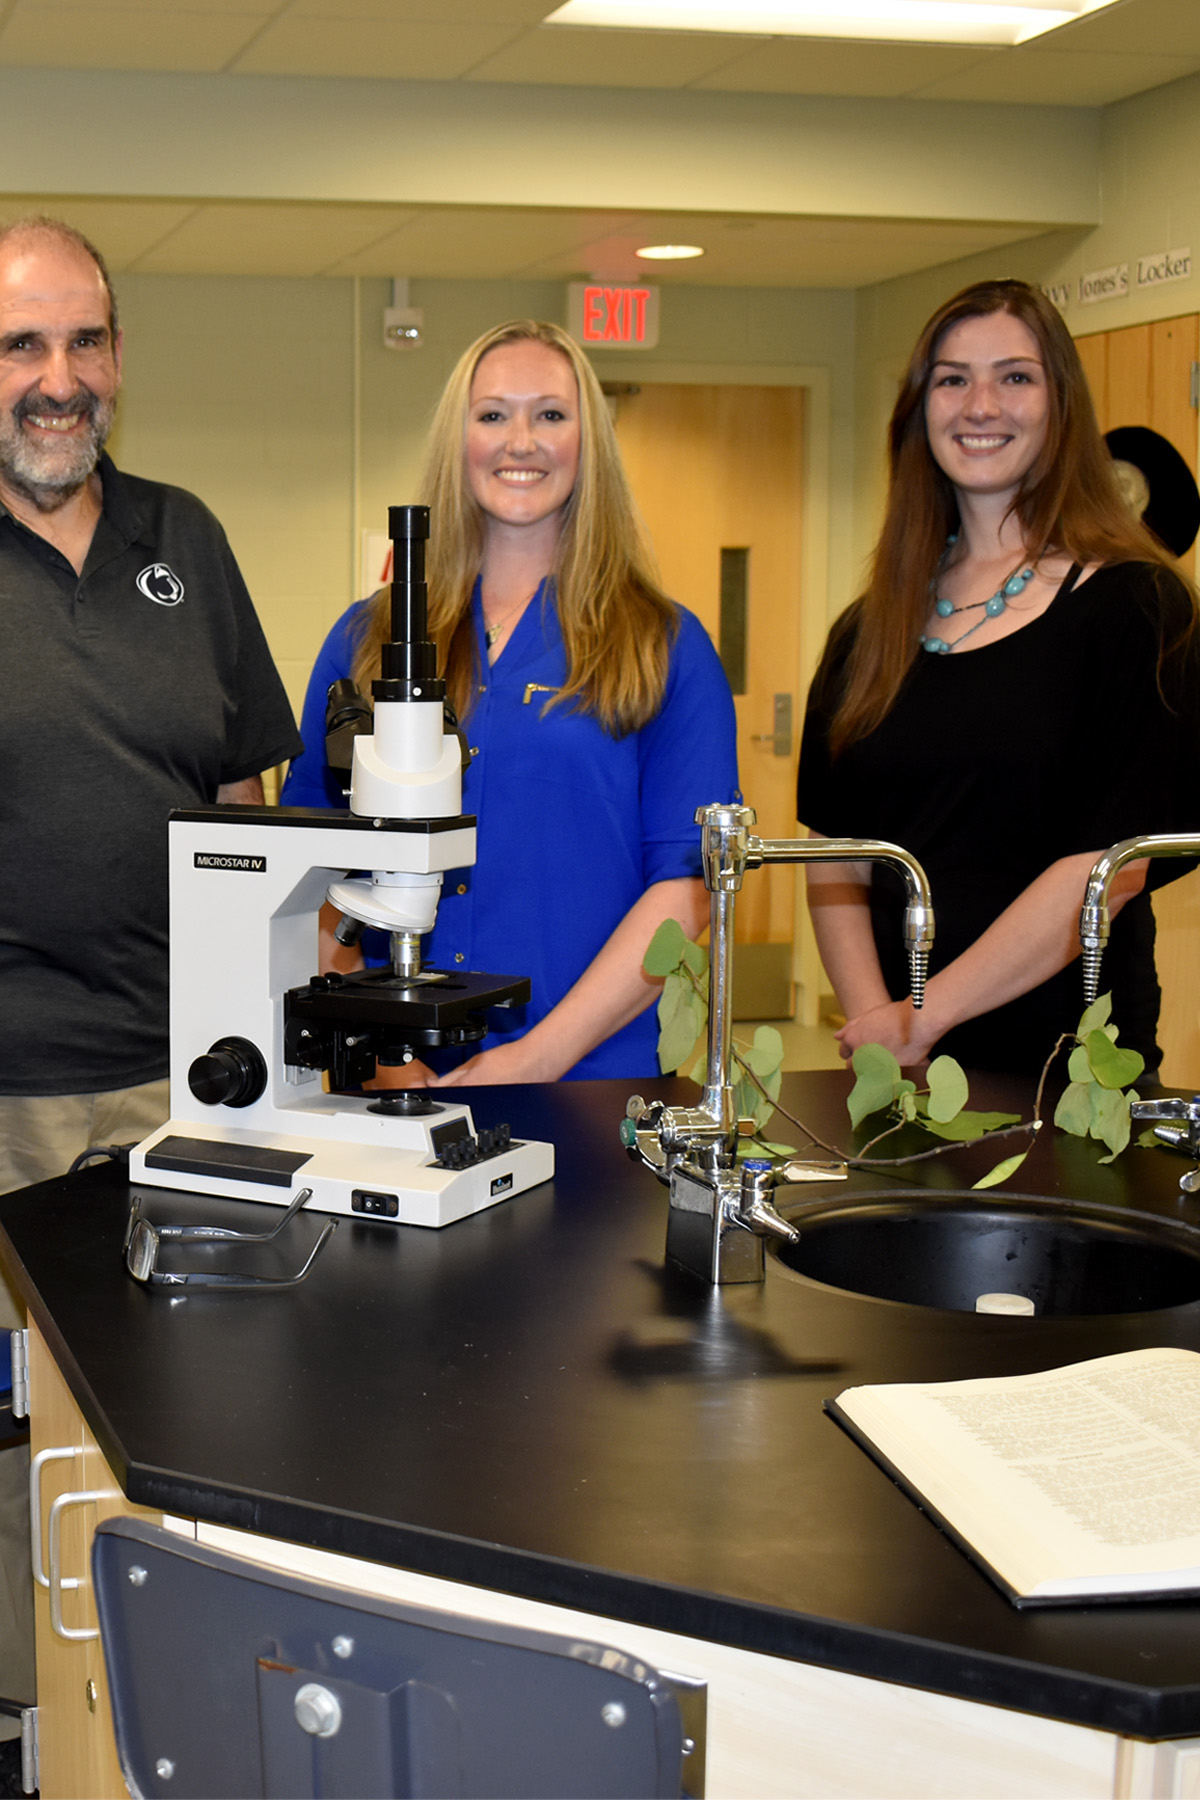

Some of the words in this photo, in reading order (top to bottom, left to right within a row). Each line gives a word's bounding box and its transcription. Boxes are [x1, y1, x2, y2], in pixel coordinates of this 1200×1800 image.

[1079, 265, 1128, 302] Jones's
[1137, 254, 1191, 285] Locker
[583, 287, 650, 342] EXIT
[197, 856, 250, 868] MICROSTAR
[251, 860, 263, 869] IV
